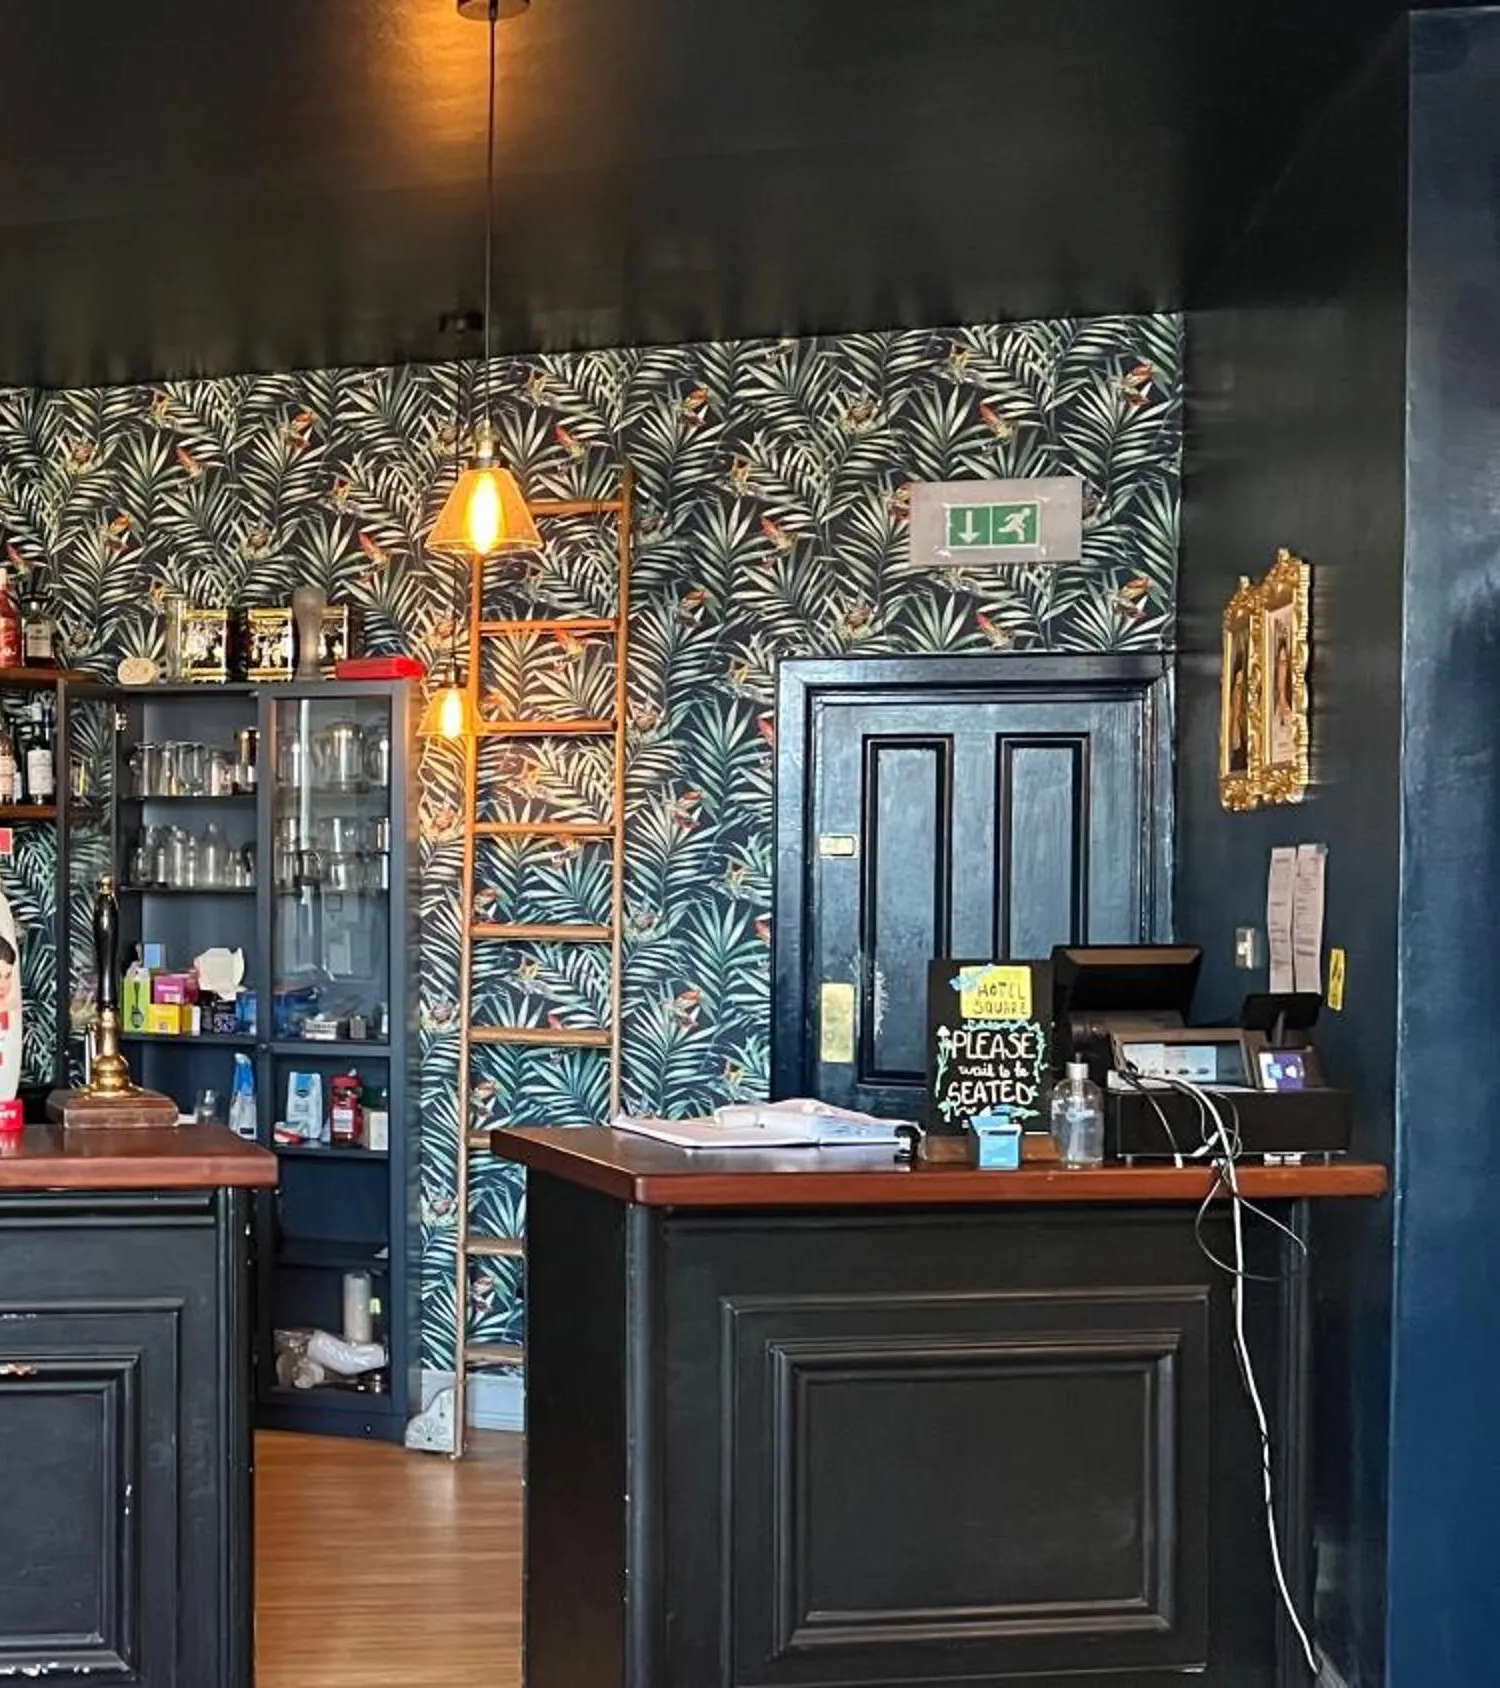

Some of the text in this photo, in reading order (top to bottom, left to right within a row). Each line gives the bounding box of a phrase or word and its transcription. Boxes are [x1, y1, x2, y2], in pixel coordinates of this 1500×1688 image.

[952, 1030, 1036, 1060] PLEASE
[958, 1063, 996, 1077] wait
[948, 1080, 1033, 1107] SEATED
